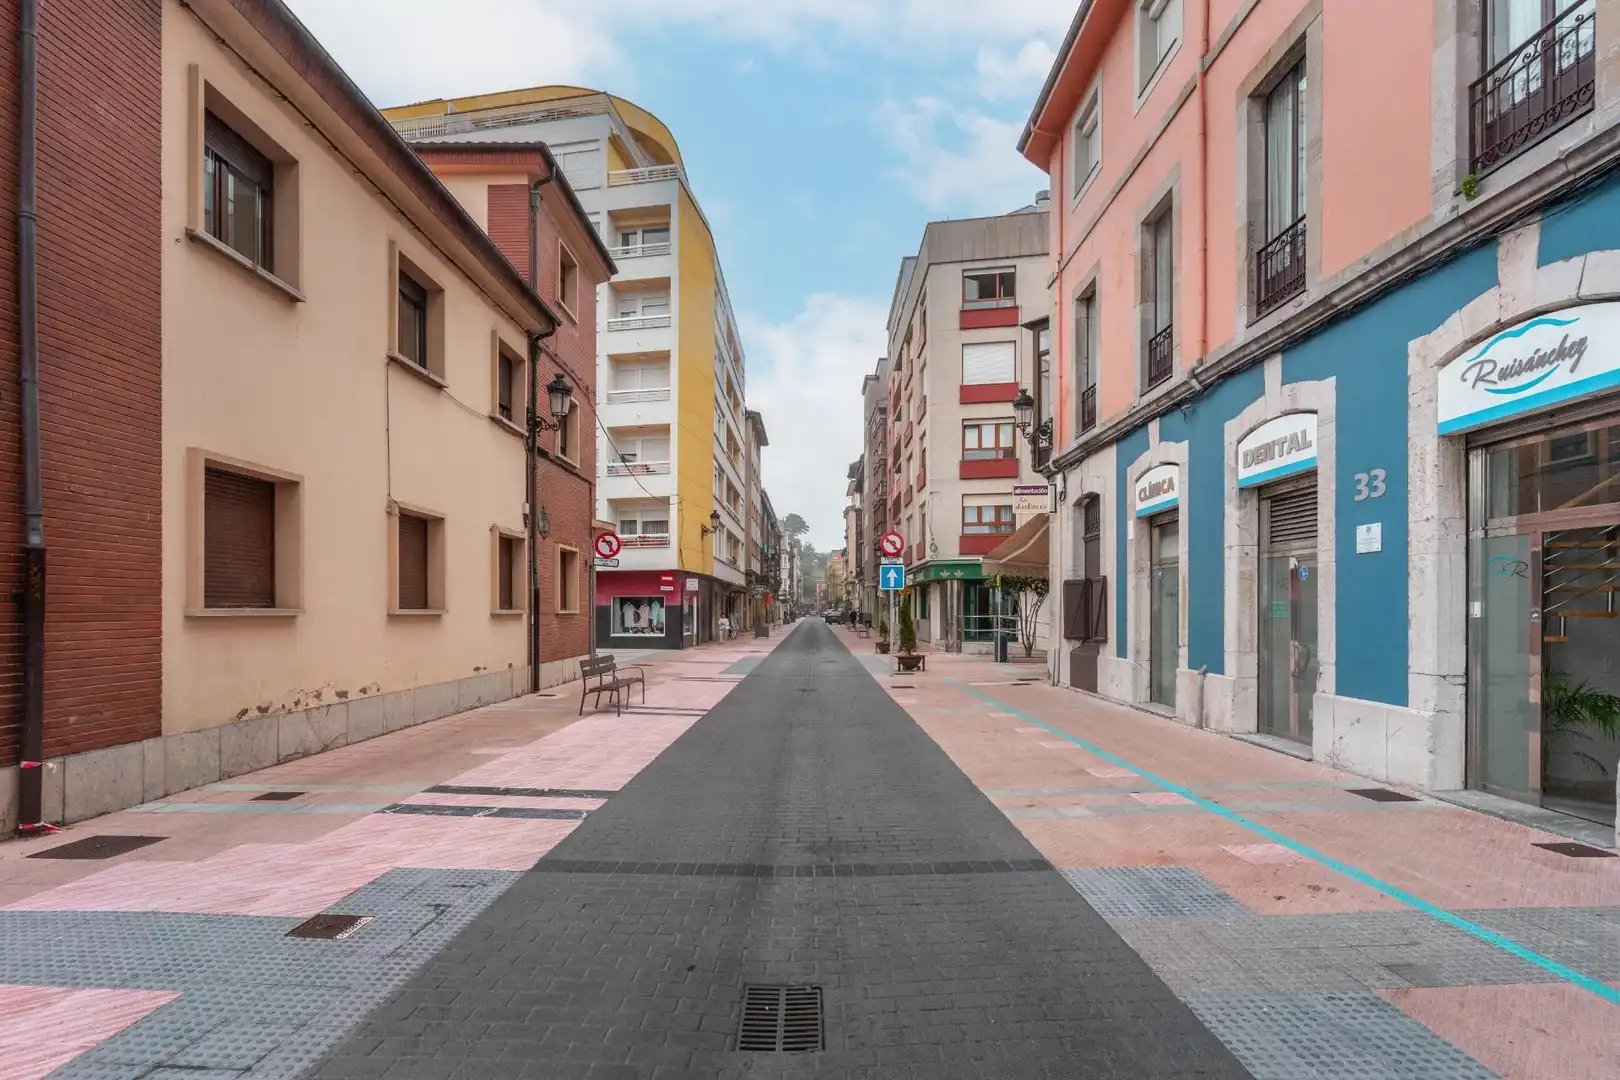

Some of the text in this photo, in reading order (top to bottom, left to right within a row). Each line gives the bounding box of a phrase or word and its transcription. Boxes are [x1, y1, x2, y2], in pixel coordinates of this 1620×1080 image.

[1460, 333, 1588, 390] Ruisánchez
[1242, 429, 1312, 469] DENTAL
[1014, 487, 1048, 495] alimentación
[1138, 476, 1175, 502] CLÍNICA
[1354, 468, 1386, 501] 33
